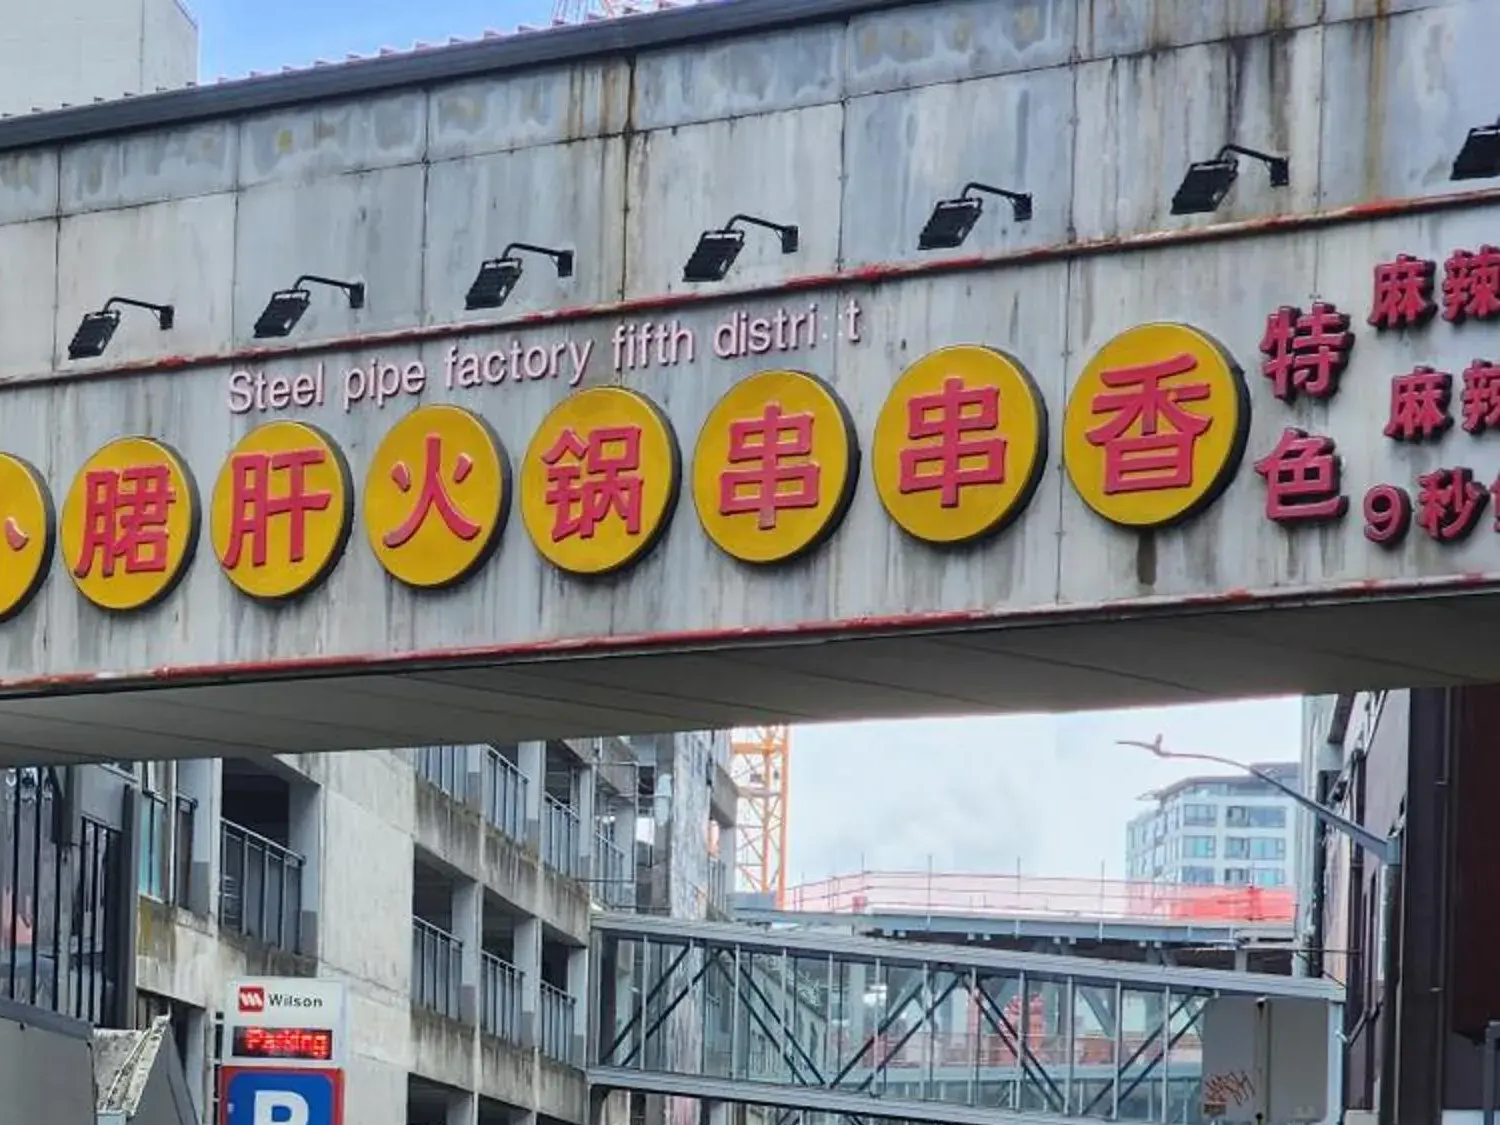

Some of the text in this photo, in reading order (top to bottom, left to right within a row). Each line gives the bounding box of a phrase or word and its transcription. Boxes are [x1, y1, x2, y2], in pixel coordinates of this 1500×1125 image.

[228, 360, 325, 414] Steel
[342, 356, 426, 413] pipe
[444, 339, 595, 390] factory
[611, 319, 696, 373] fifth
[267, 992, 324, 1009] Wilson
